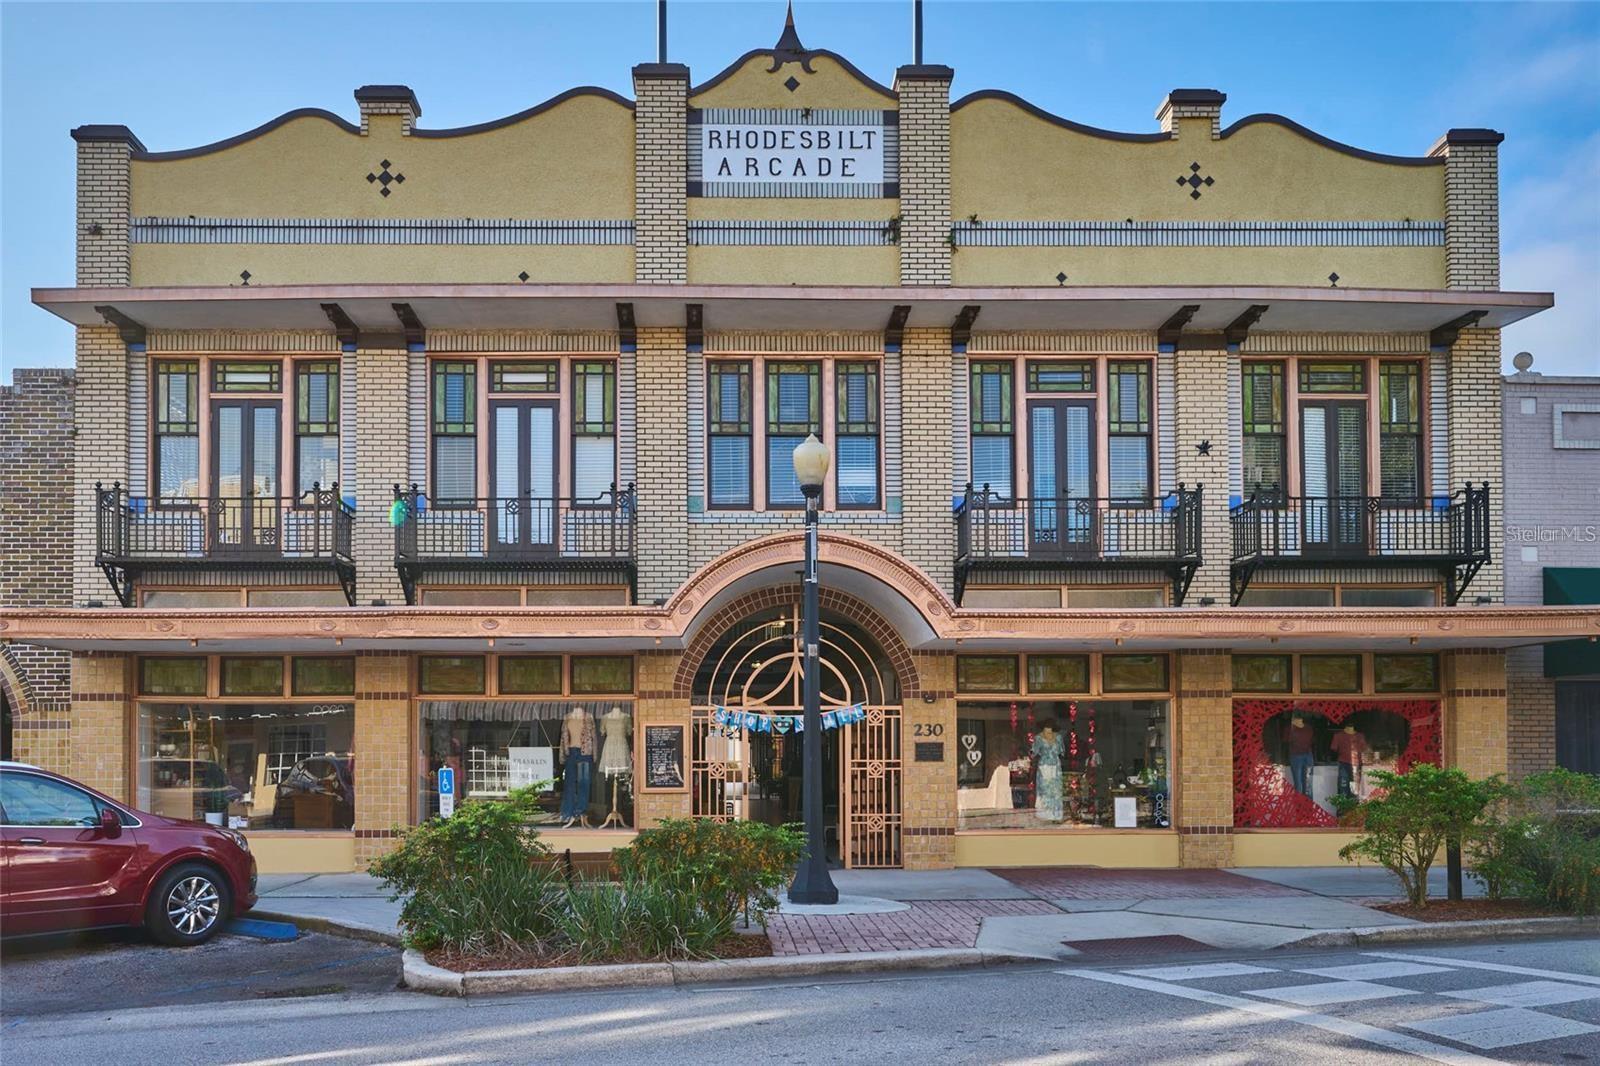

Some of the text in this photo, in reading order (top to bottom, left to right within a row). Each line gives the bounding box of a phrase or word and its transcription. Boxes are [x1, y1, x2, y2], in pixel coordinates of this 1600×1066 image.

[708, 130, 877, 149] RHODESBILT
[717, 157, 856, 177] ARCADE
[718, 707, 862, 729] SHOP SALL
[913, 723, 944, 737] 230
